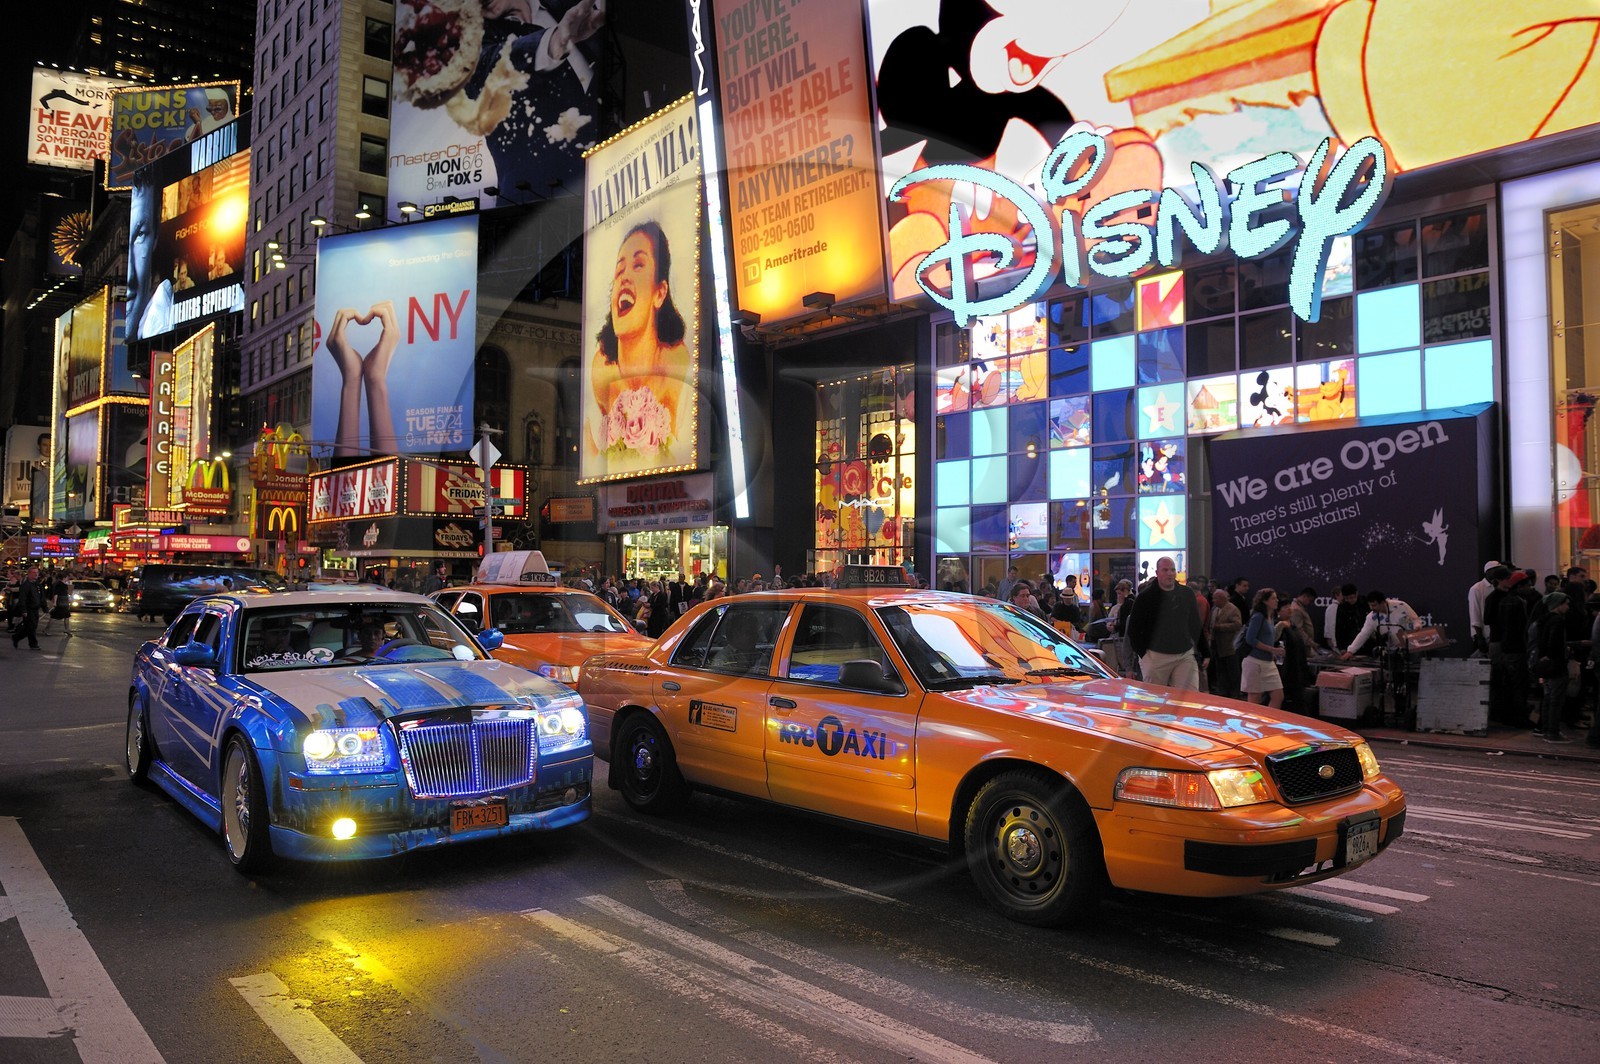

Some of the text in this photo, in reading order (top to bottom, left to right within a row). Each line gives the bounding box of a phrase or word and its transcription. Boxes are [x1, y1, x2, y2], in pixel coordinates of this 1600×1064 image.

[720, 0, 786, 46] YOU'VE
[723, 13, 799, 81] IT HERE.
[726, 41, 817, 114] BUT WILL
[117, 90, 187, 113] NUNS
[729, 57, 853, 145] YOU BE ABLE
[36, 134, 106, 149] SOMETHING
[37, 125, 57, 135] ON
[732, 105, 831, 179] TO RETIRE
[36, 143, 50, 156] A
[191, 121, 238, 174] WARRIOR
[389, 139, 484, 168] MasterChef
[427, 153, 483, 176] MON 6/6
[447, 171, 471, 187] FOX
[473, 169, 482, 182] 5
[591, 116, 695, 230] MAMMA MIA!
[737, 133, 854, 213] ANYWHERE?
[740, 169, 870, 235] ASK TEAM RETIREMENT.
[175, 223, 198, 240] FIGHTS
[740, 212, 815, 256] 800-290-0500
[764, 240, 828, 270] Ameritrade
[202, 283, 241, 316] SEPTEMBER
[407, 289, 471, 345] NY
[156, 361, 173, 475] PALACE
[406, 405, 463, 417] SEASON FINALE
[406, 414, 463, 432] TUE 5/24
[426, 430, 452, 445] FOX
[453, 429, 463, 444] 5
[1216, 421, 1450, 508] We are Open
[185, 490, 230, 500] McDonald's
[626, 480, 688, 503] DIGITAL
[657, 498, 710, 514] COMPUTERS
[1230, 469, 1398, 531] There's still plenty of
[1234, 501, 1361, 549] Magic upstairs!
[863, 569, 886, 583] 9B26
[1314, 595, 1334, 607] ar
[779, 724, 815, 749] NYC
